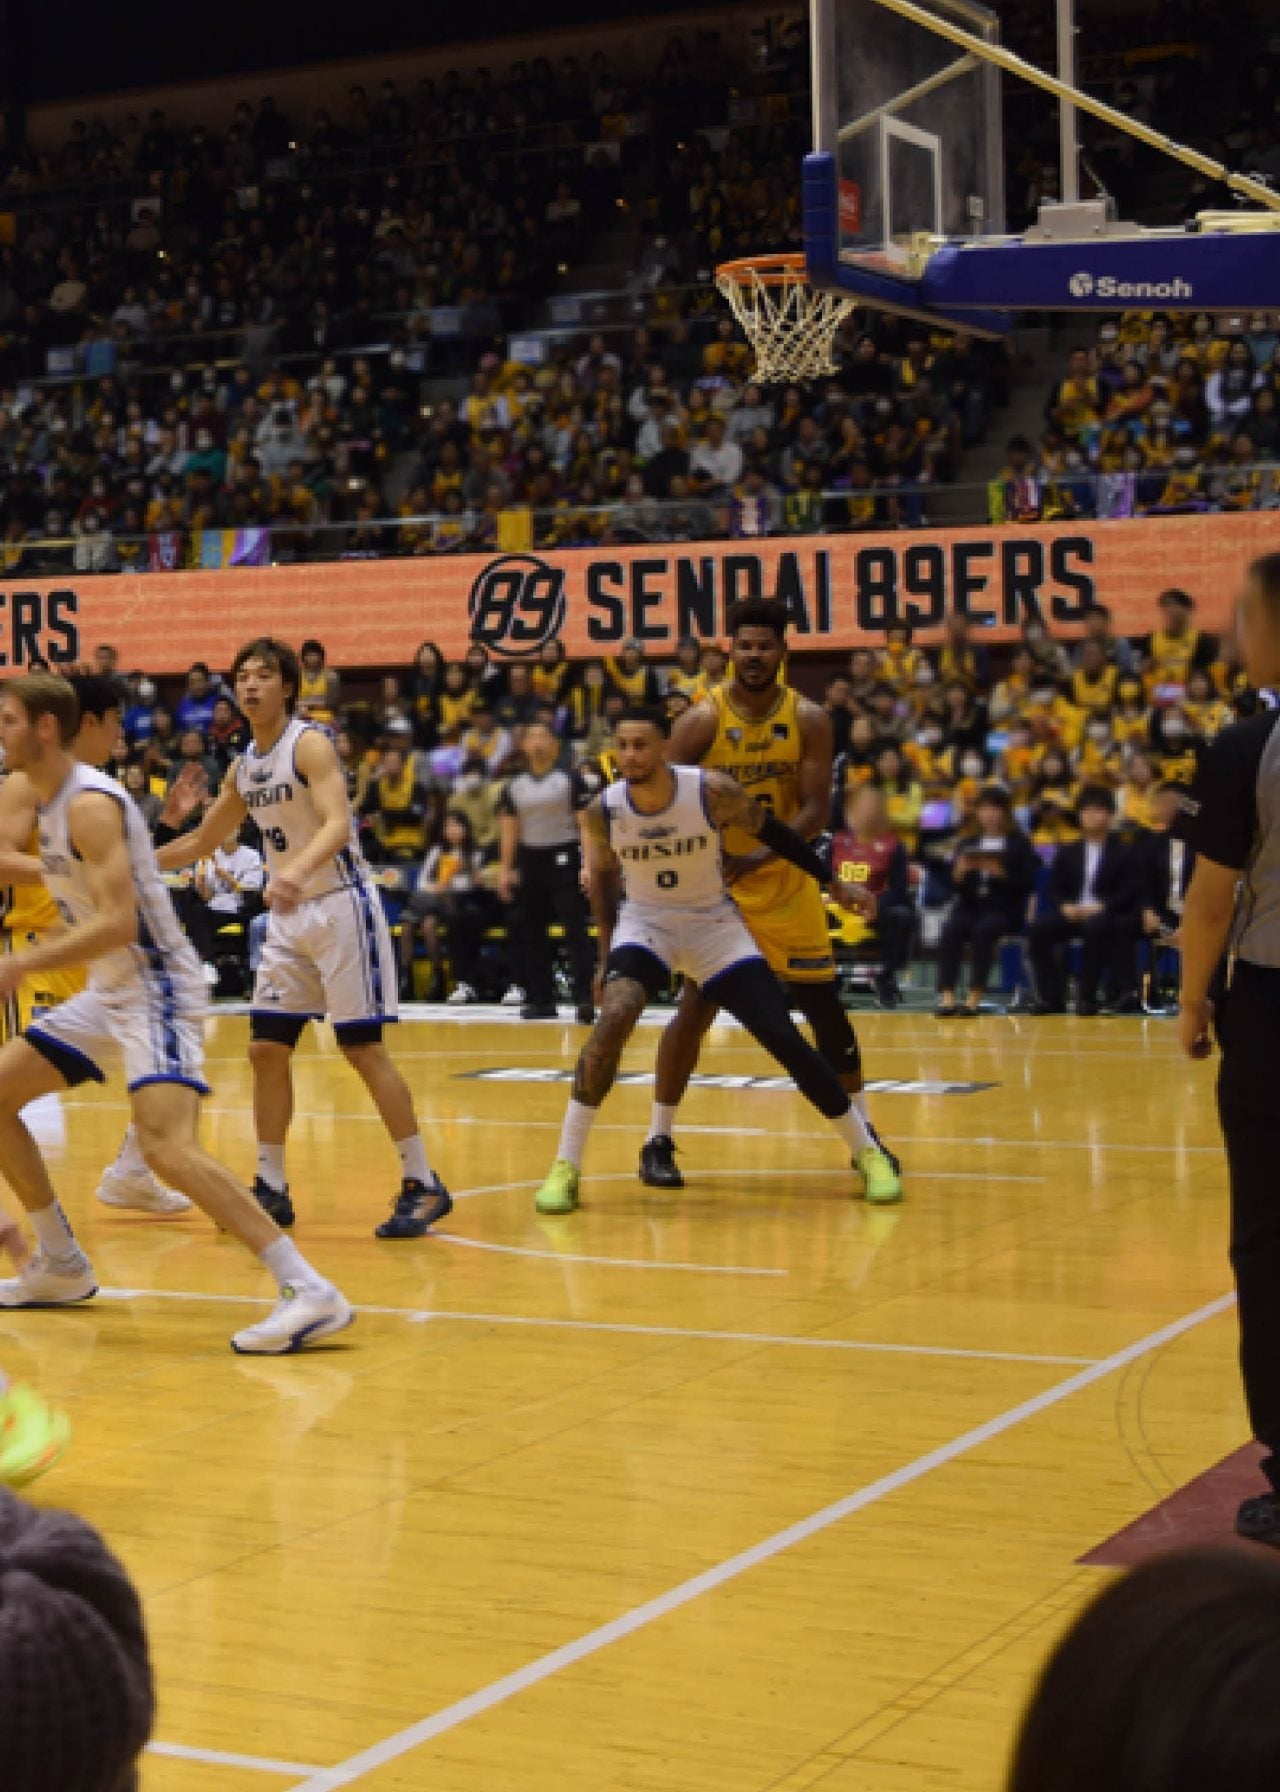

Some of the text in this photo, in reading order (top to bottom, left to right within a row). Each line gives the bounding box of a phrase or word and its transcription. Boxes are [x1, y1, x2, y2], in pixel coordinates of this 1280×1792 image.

[1096, 277, 1193, 299] Senoh
[586, 550, 833, 641] SENDAI
[855, 536, 1095, 631] 89ERS
